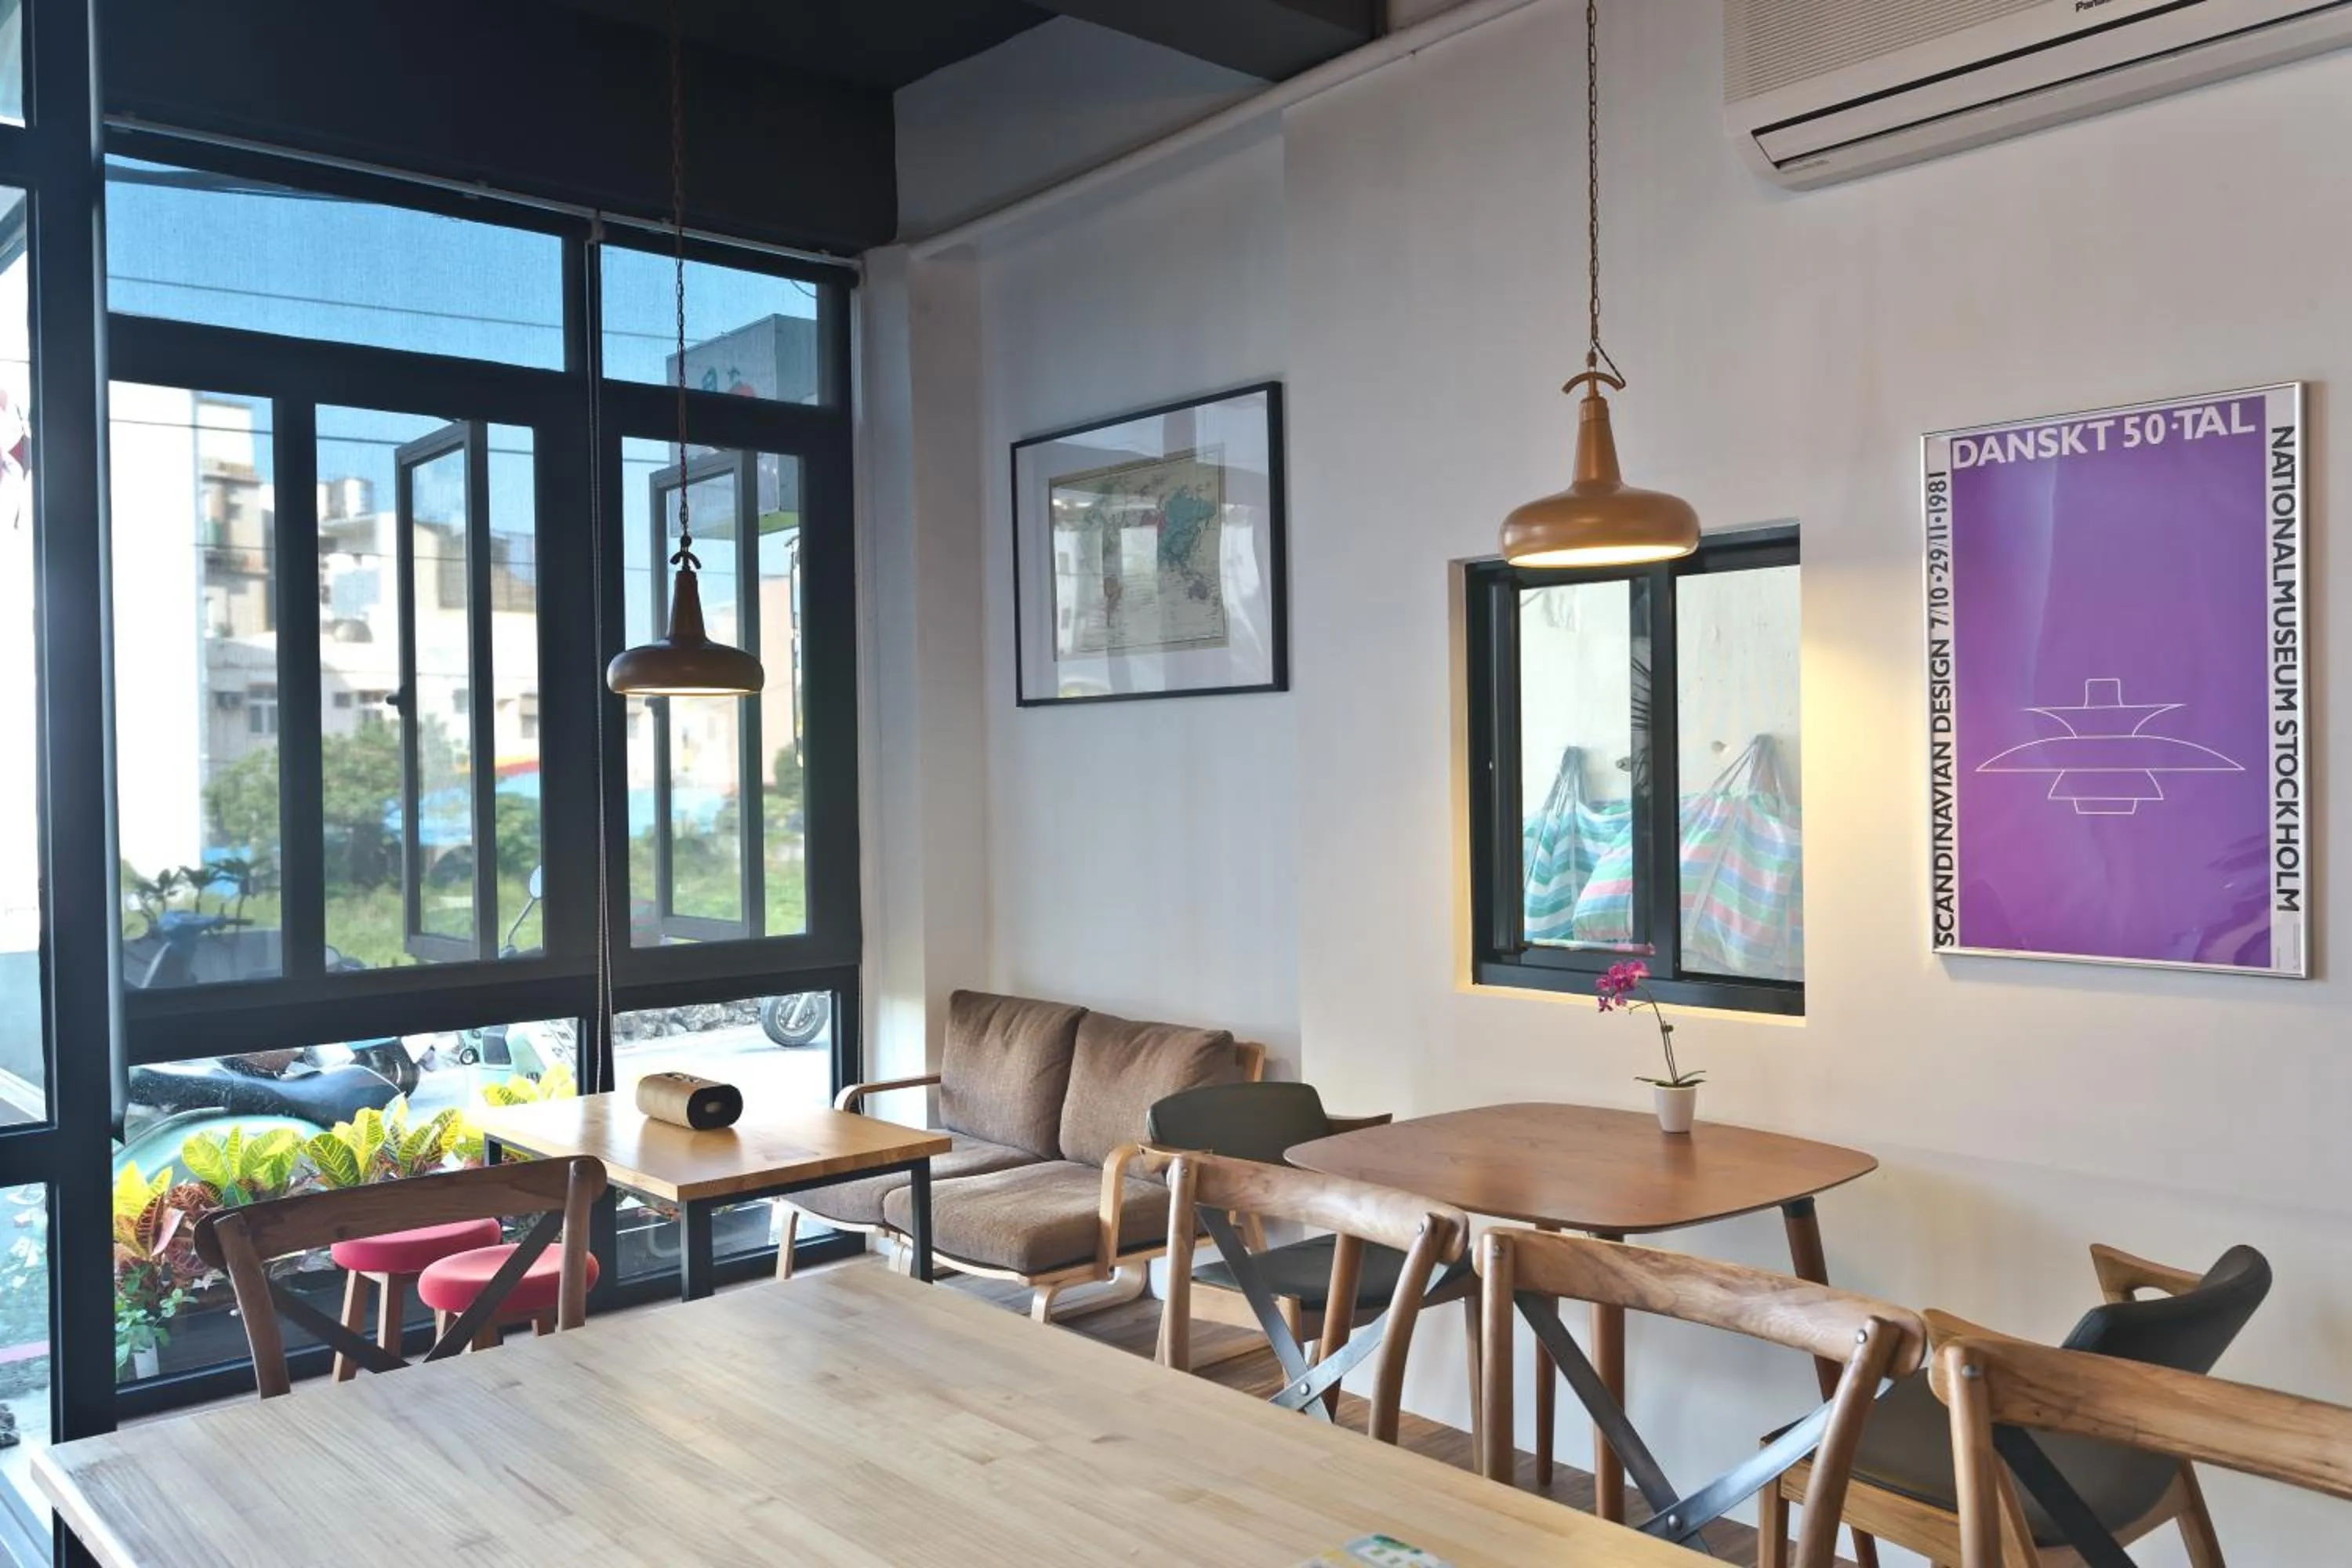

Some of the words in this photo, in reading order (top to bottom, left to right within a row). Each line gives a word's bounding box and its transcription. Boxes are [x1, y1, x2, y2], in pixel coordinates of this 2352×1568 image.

[1952, 419, 2114, 469] DANSKT
[2271, 426, 2297, 712] NATIONALMUSEUM
[1931, 639, 1952, 734] DESIGN
[1933, 742, 1955, 947] SCANDINAVIAN
[2274, 718, 2299, 912] STOCKHOLM
